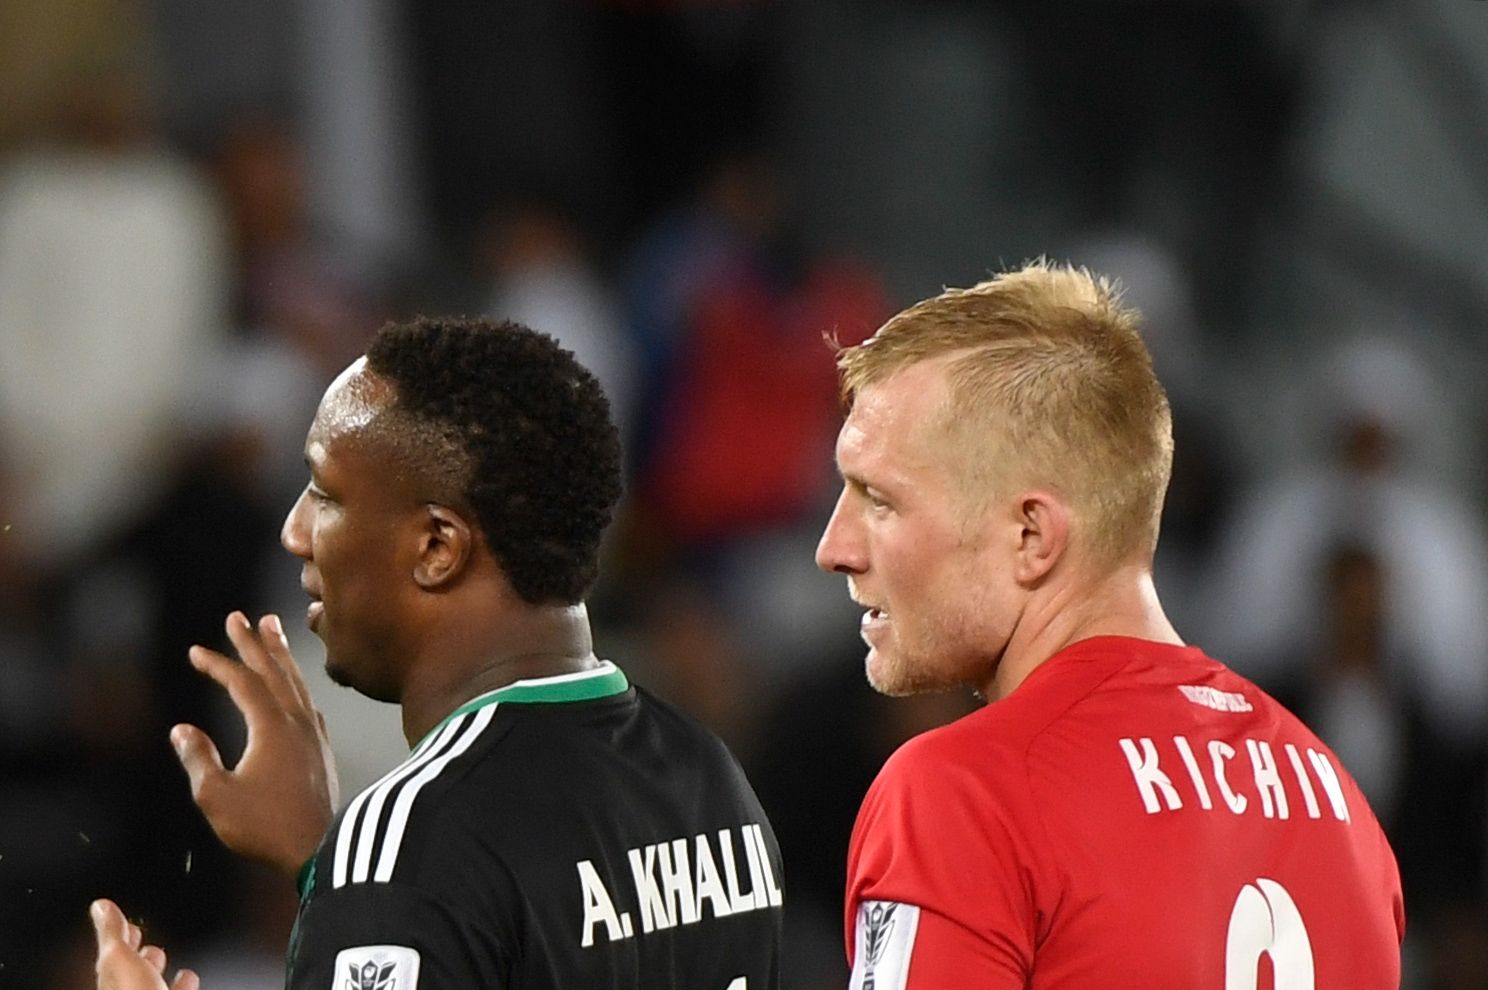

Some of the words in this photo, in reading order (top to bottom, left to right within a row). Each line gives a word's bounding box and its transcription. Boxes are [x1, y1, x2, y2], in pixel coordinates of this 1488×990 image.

[1119, 735, 1351, 824] KICHIN
[576, 859, 633, 947] A.
[628, 823, 784, 933] KHALIL
